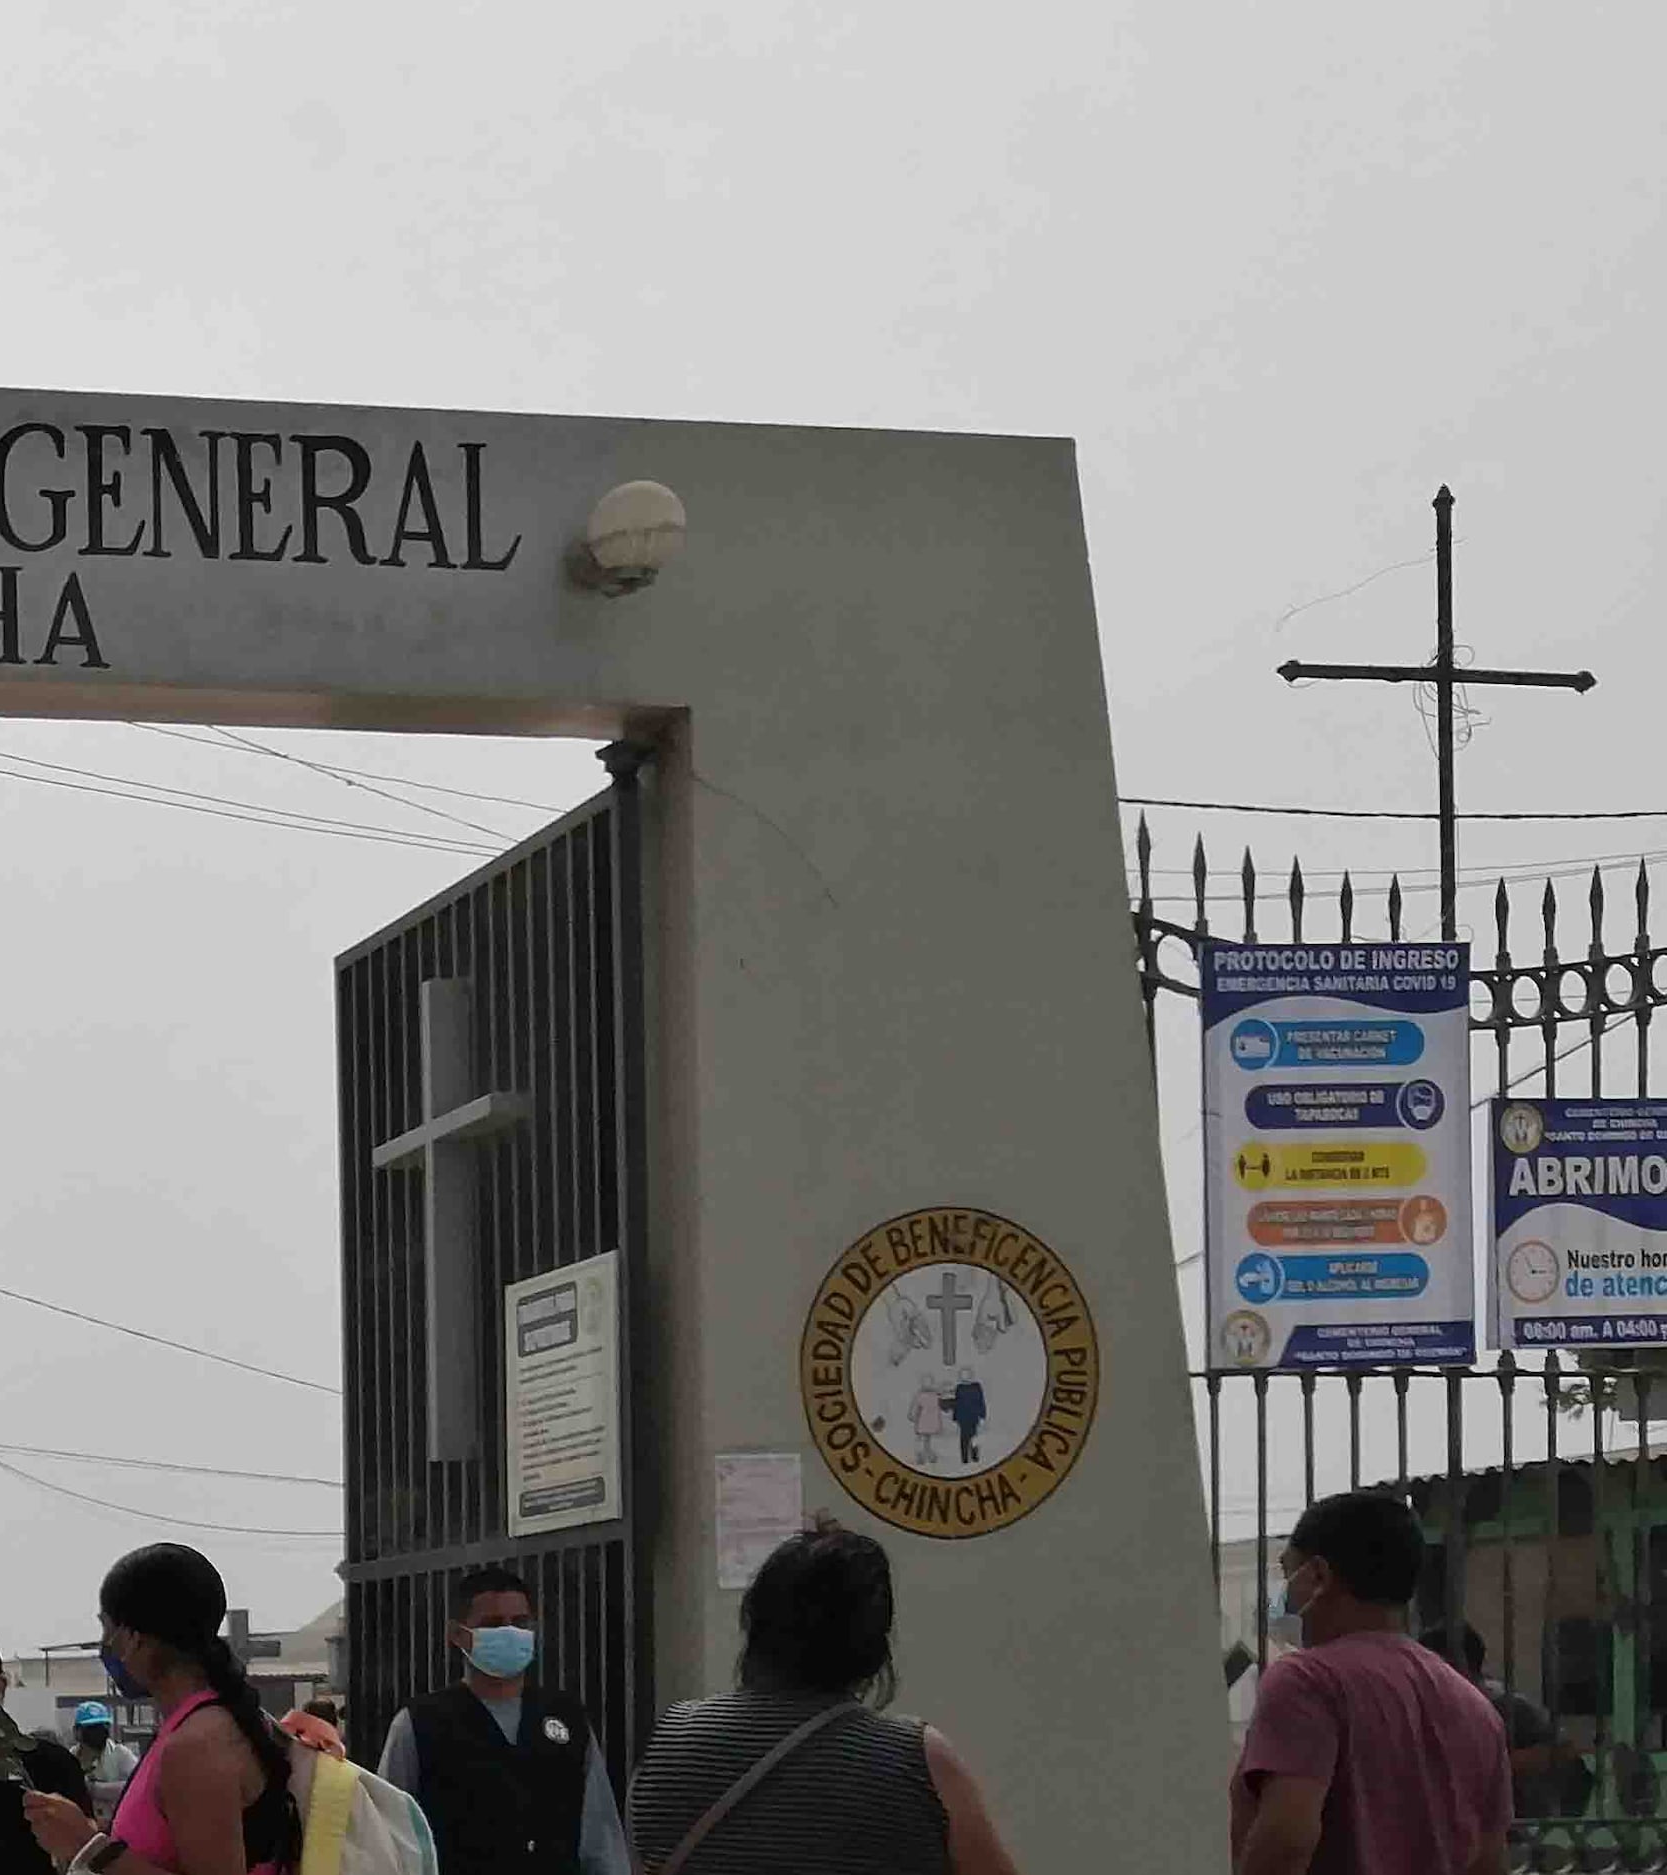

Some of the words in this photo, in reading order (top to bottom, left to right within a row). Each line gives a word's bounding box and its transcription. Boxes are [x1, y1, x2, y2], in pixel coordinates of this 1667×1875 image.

[1214, 951, 1334, 971] PROTOCOLO
[1340, 951, 1366, 970] DE
[1372, 950, 1459, 969] INGRESO
[1217, 976, 1310, 992] EMERGENCIA
[1313, 975, 1389, 991] SANITARIA
[1393, 974, 1436, 991] COVID
[841, 1241, 889, 1295] DE
[886, 1215, 1077, 1338] BENEFICENCIA
[1567, 1250, 1634, 1269] Nuestro
[1565, 1270, 1593, 1297] de
[1603, 1320, 1613, 1338] A
[812, 1293, 872, 1473] SOCIEDAD
[1024, 1346, 1087, 1474] PUBLICA
[875, 1470, 1021, 1526] CHINCHA
